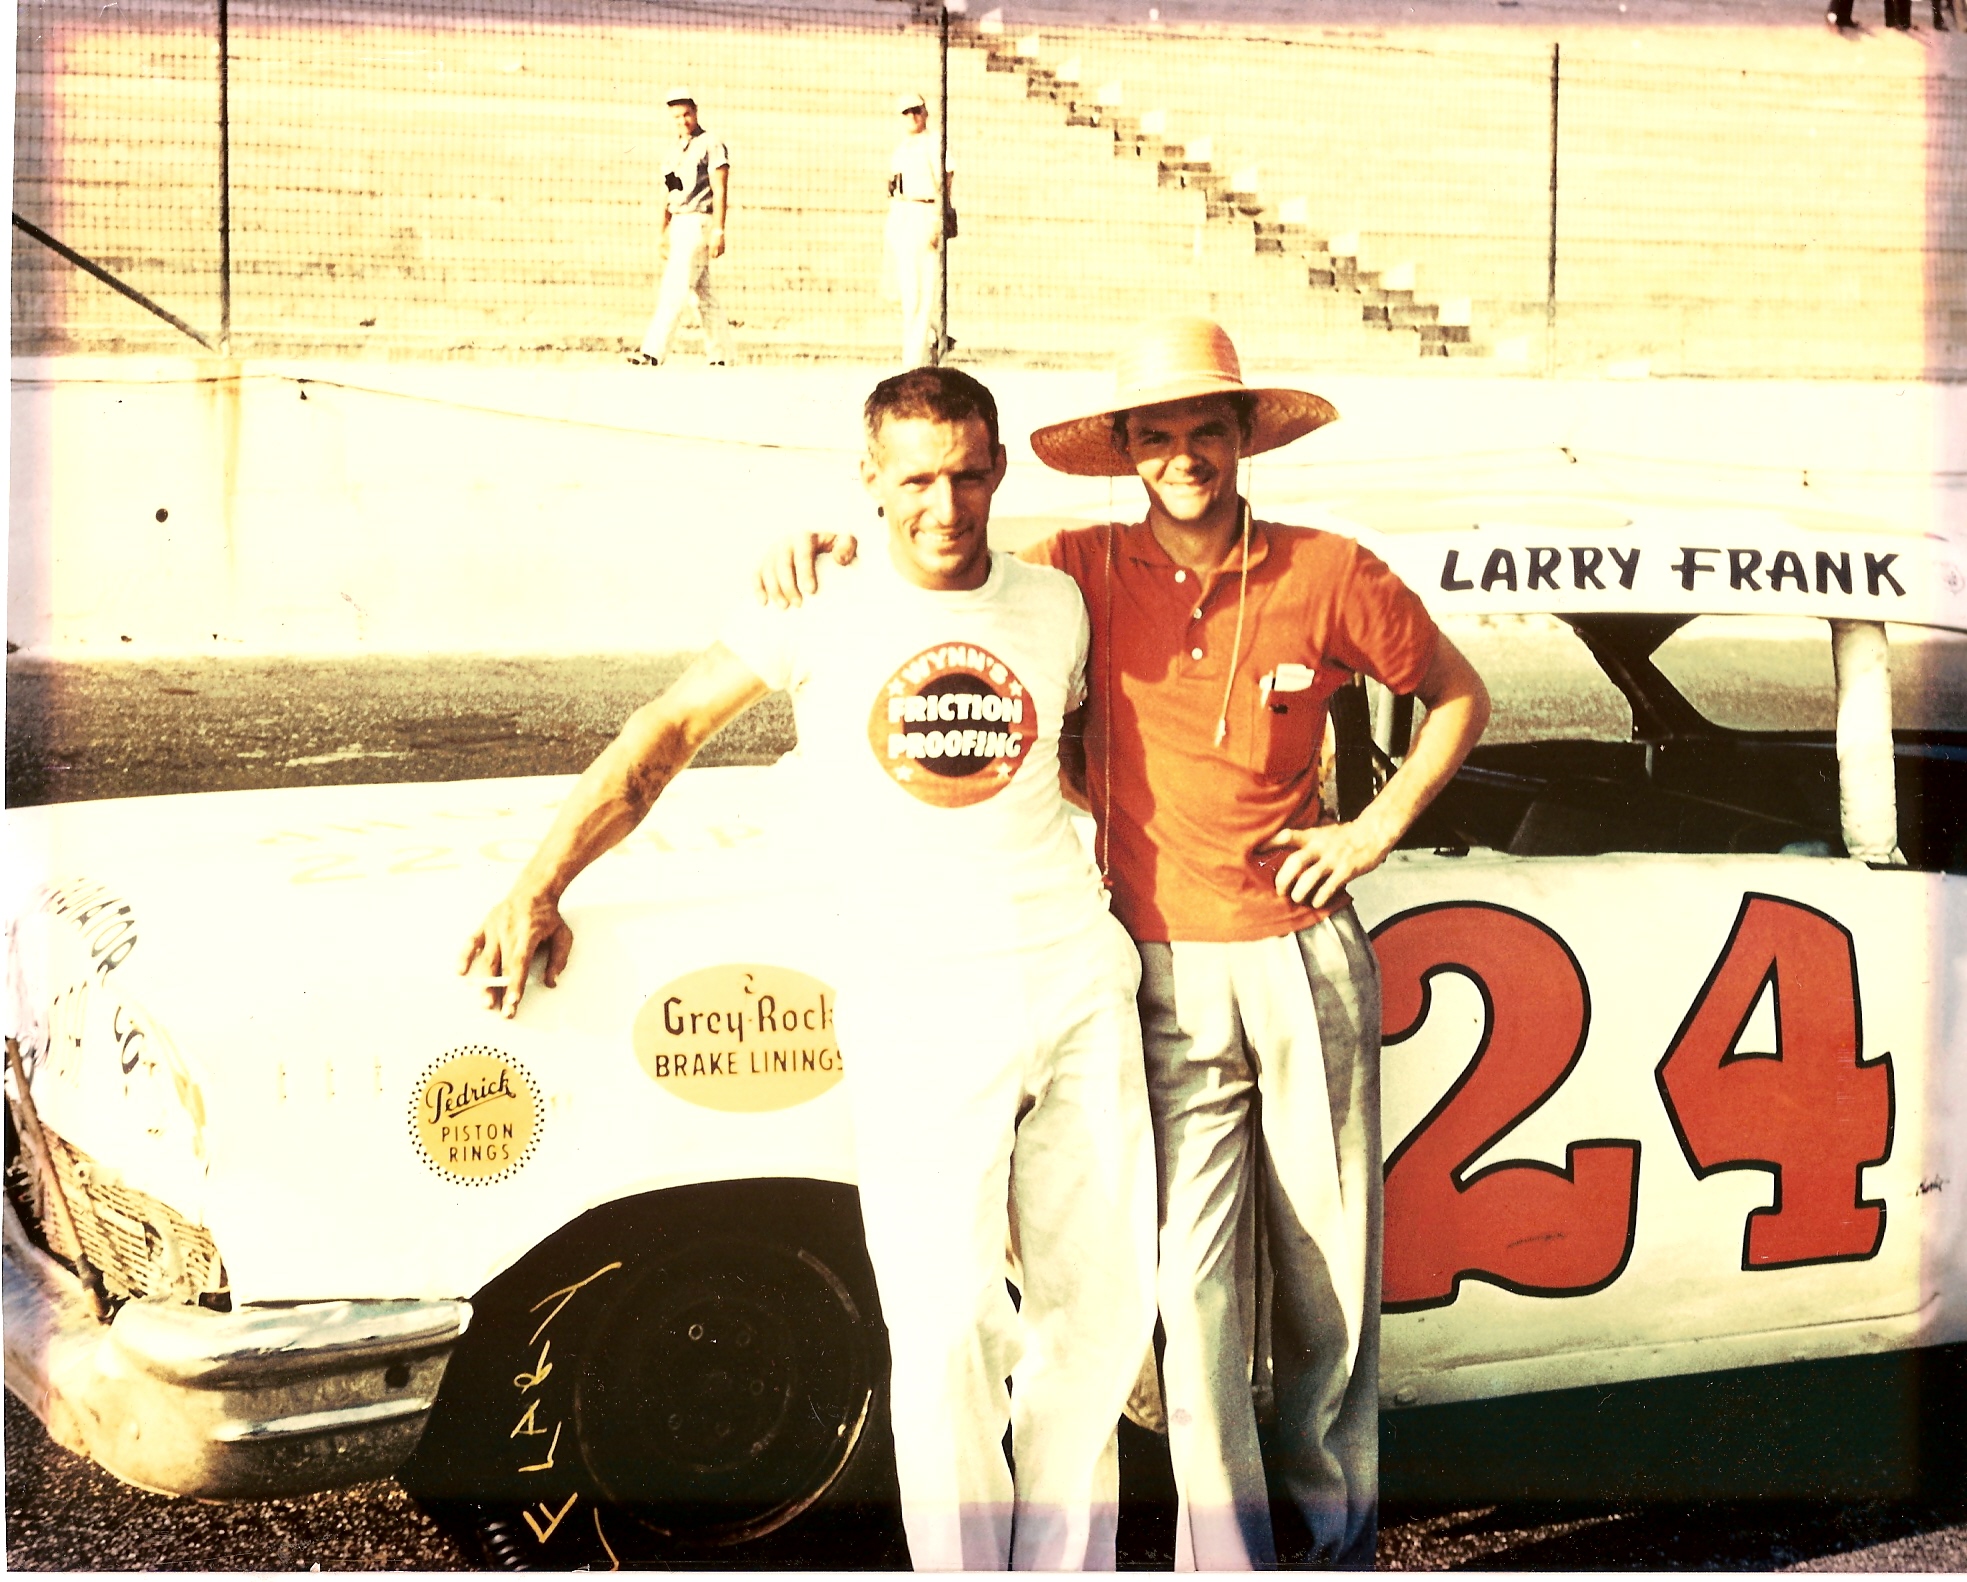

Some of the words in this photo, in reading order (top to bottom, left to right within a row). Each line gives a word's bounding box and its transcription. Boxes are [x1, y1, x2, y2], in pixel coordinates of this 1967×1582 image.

[1440, 547, 1641, 592] LARRY
[1671, 546, 1907, 597] FRANK
[901, 645, 1009, 686] WYNN'S
[888, 693, 1023, 724] FRICTION
[888, 729, 1023, 760] PROOFING
[655, 1052, 738, 1078] BRAKE
[425, 1068, 517, 1125] Pedrick
[1369, 891, 1896, 1314] 24
[441, 1122, 513, 1143] PISTON
[449, 1143, 509, 1163] RINGS
